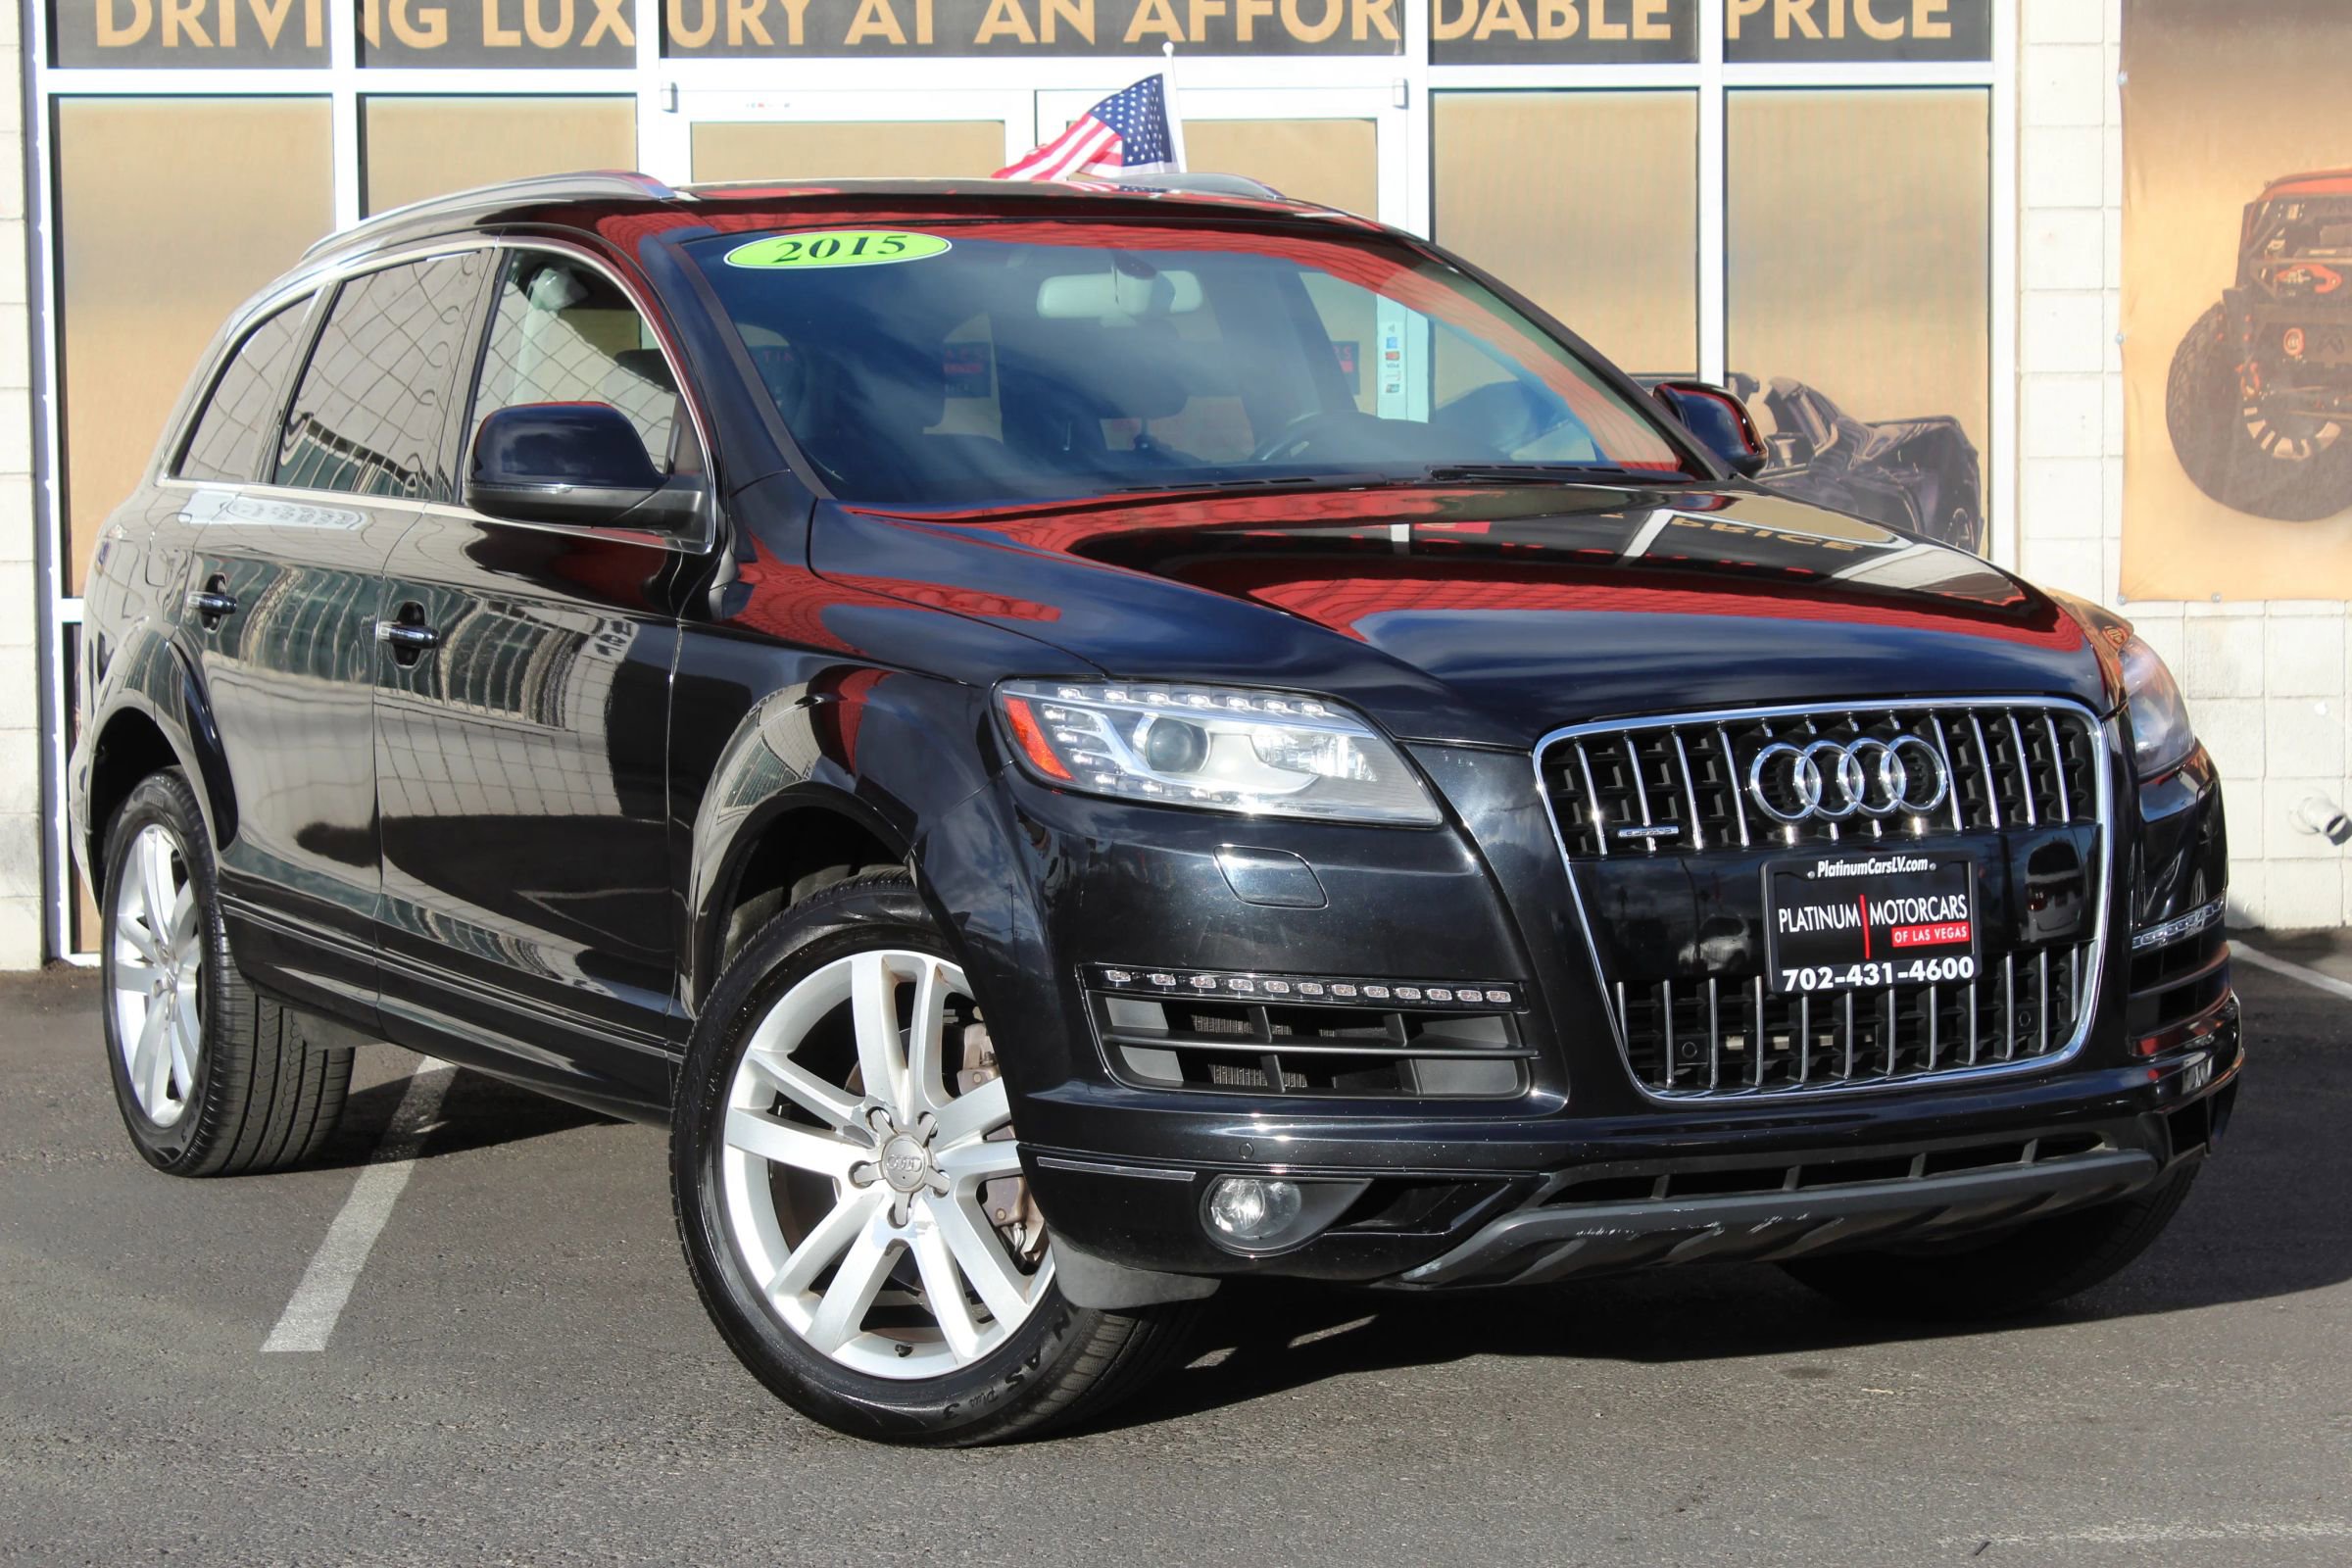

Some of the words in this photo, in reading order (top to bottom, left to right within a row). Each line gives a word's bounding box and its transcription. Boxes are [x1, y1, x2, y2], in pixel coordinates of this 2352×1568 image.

[482, 0, 810, 49] LUXURY
[973, 0, 1096, 46] AN
[1123, 0, 1672, 43] AFFORDABLE
[1727, 0, 1952, 41] PRICE
[772, 235, 907, 264] 2015
[1817, 856, 1929, 878] PlatinumCarsLV.com
[1778, 903, 1862, 934] PLATINUM
[1869, 894, 1968, 926] MOTORCARS
[1894, 930, 1909, 944] OF
[1912, 928, 1931, 942] LAS
[1934, 925, 1968, 941] VEGAS
[1782, 956, 1975, 992] 702-431-4600
